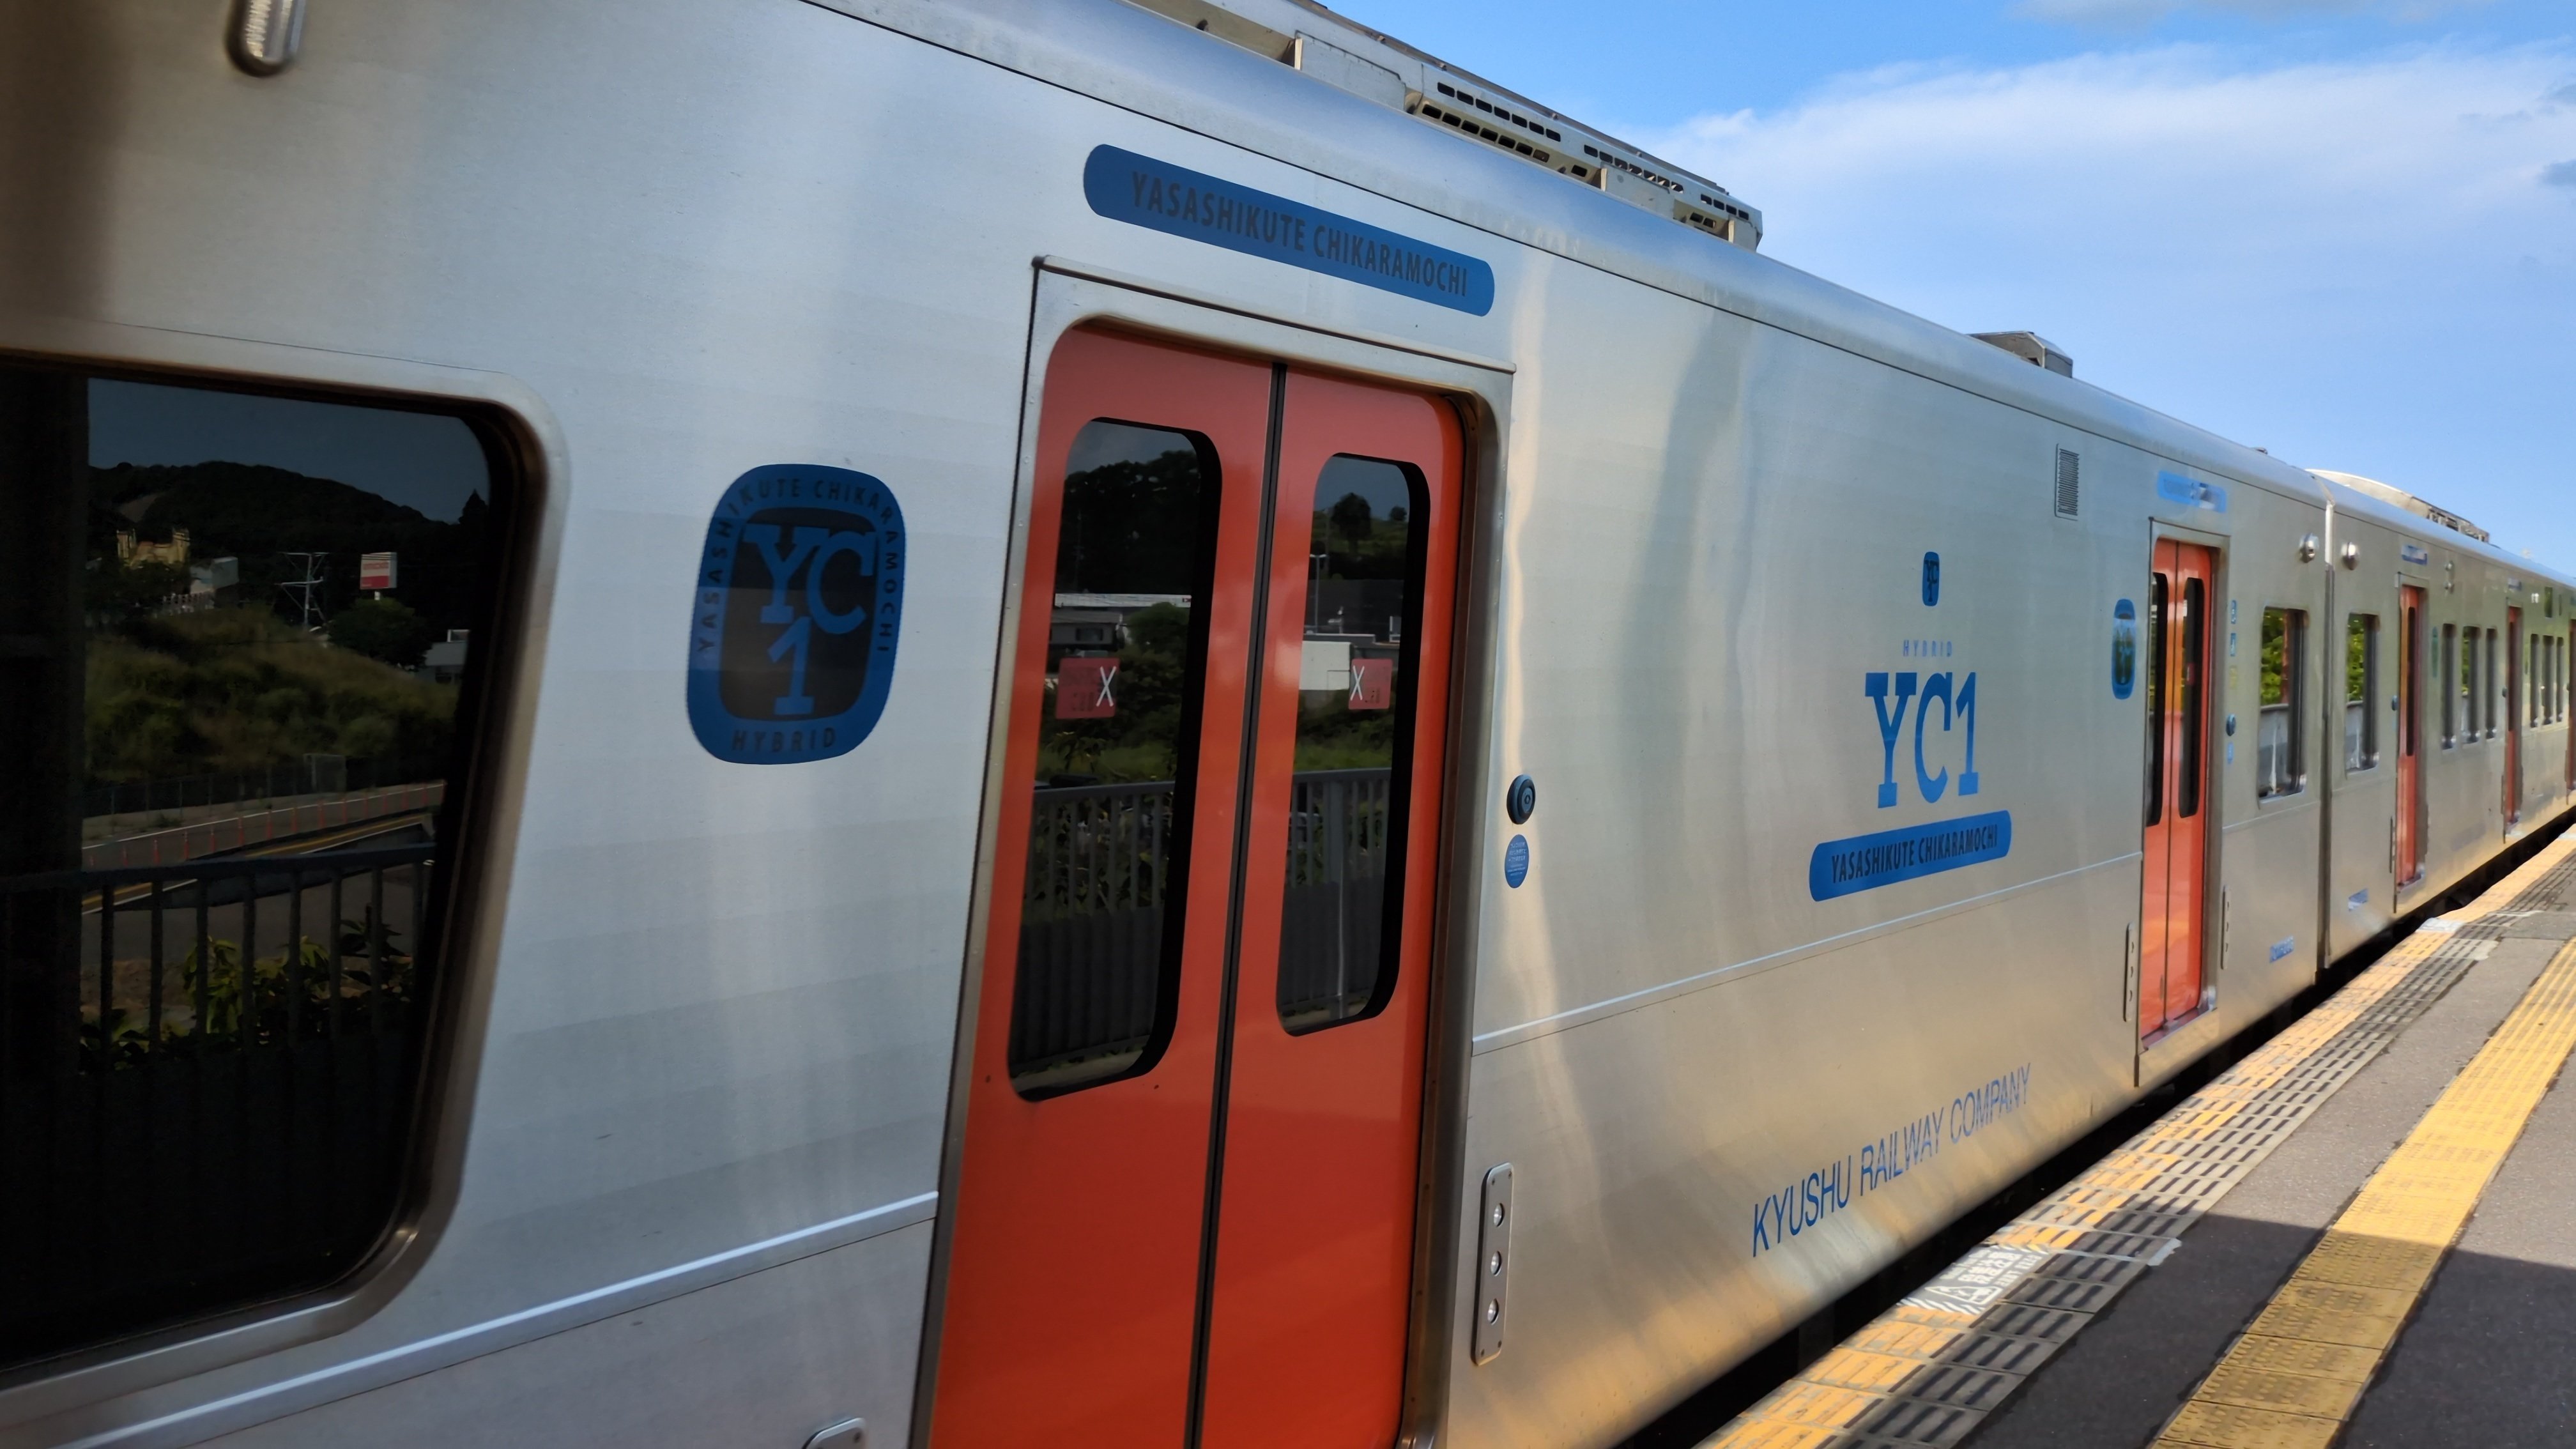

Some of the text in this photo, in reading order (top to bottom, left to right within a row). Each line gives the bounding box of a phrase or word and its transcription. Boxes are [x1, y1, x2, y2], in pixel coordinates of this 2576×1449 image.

[1131, 171, 1468, 297] YASASHIKUTE CHIKARAMOCHI
[744, 523, 877, 634] YC
[768, 617, 815, 716] 1
[1903, 640, 1952, 657] HYBRID
[732, 727, 836, 751] HYBRID
[1865, 671, 1979, 809] YC1
[1831, 824, 1998, 884] YASASHIKUTE CHIKARAMOCHI
[1752, 1062, 2031, 1258] KYUSHU RAILWAY COMPANY
